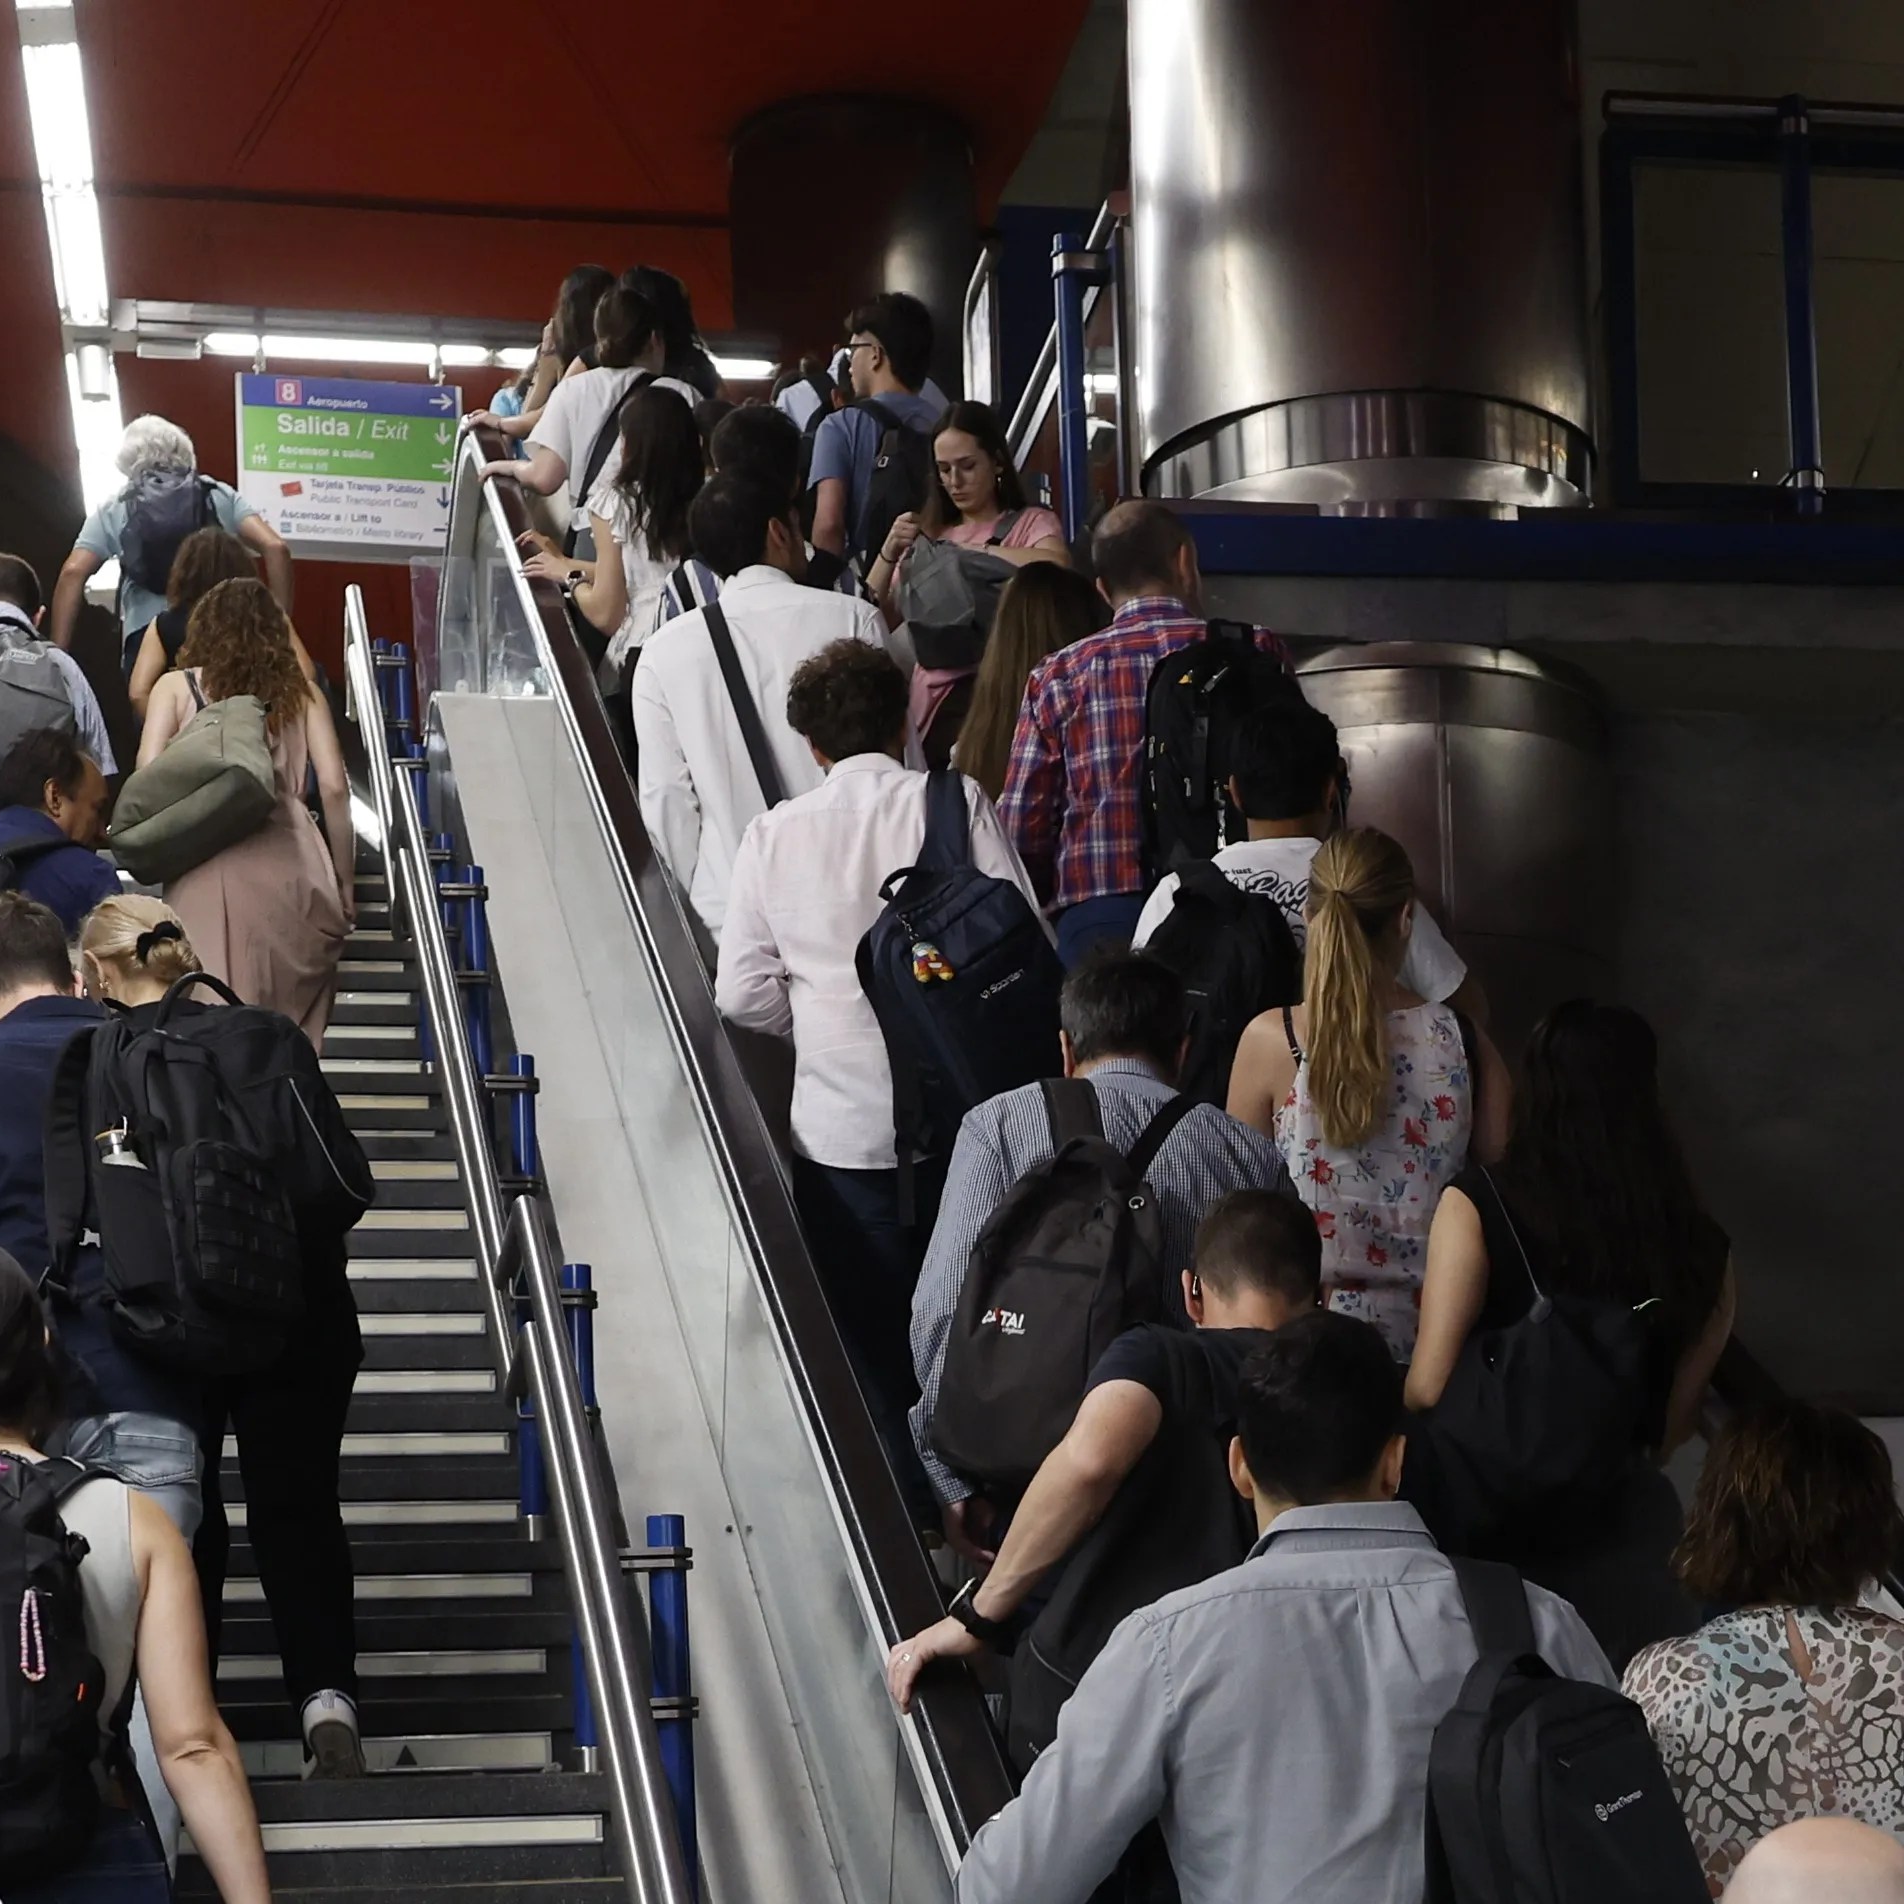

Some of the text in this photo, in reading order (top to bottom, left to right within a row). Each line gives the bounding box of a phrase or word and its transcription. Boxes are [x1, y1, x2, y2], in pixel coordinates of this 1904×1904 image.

[281, 382, 368, 409] 8 Aeropuerto
[277, 413, 410, 440] Salida / Exit
[278, 444, 330, 456] Ascensor
[278, 459, 298, 469] Exit
[310, 478, 344, 491] Tarjeta
[310, 493, 418, 508] Public Transport Card
[280, 509, 331, 520] Ascensor
[351, 513, 368, 522] Lift
[370, 515, 382, 523] to
[362, 527, 391, 538] Metro
[393, 529, 424, 540] library
